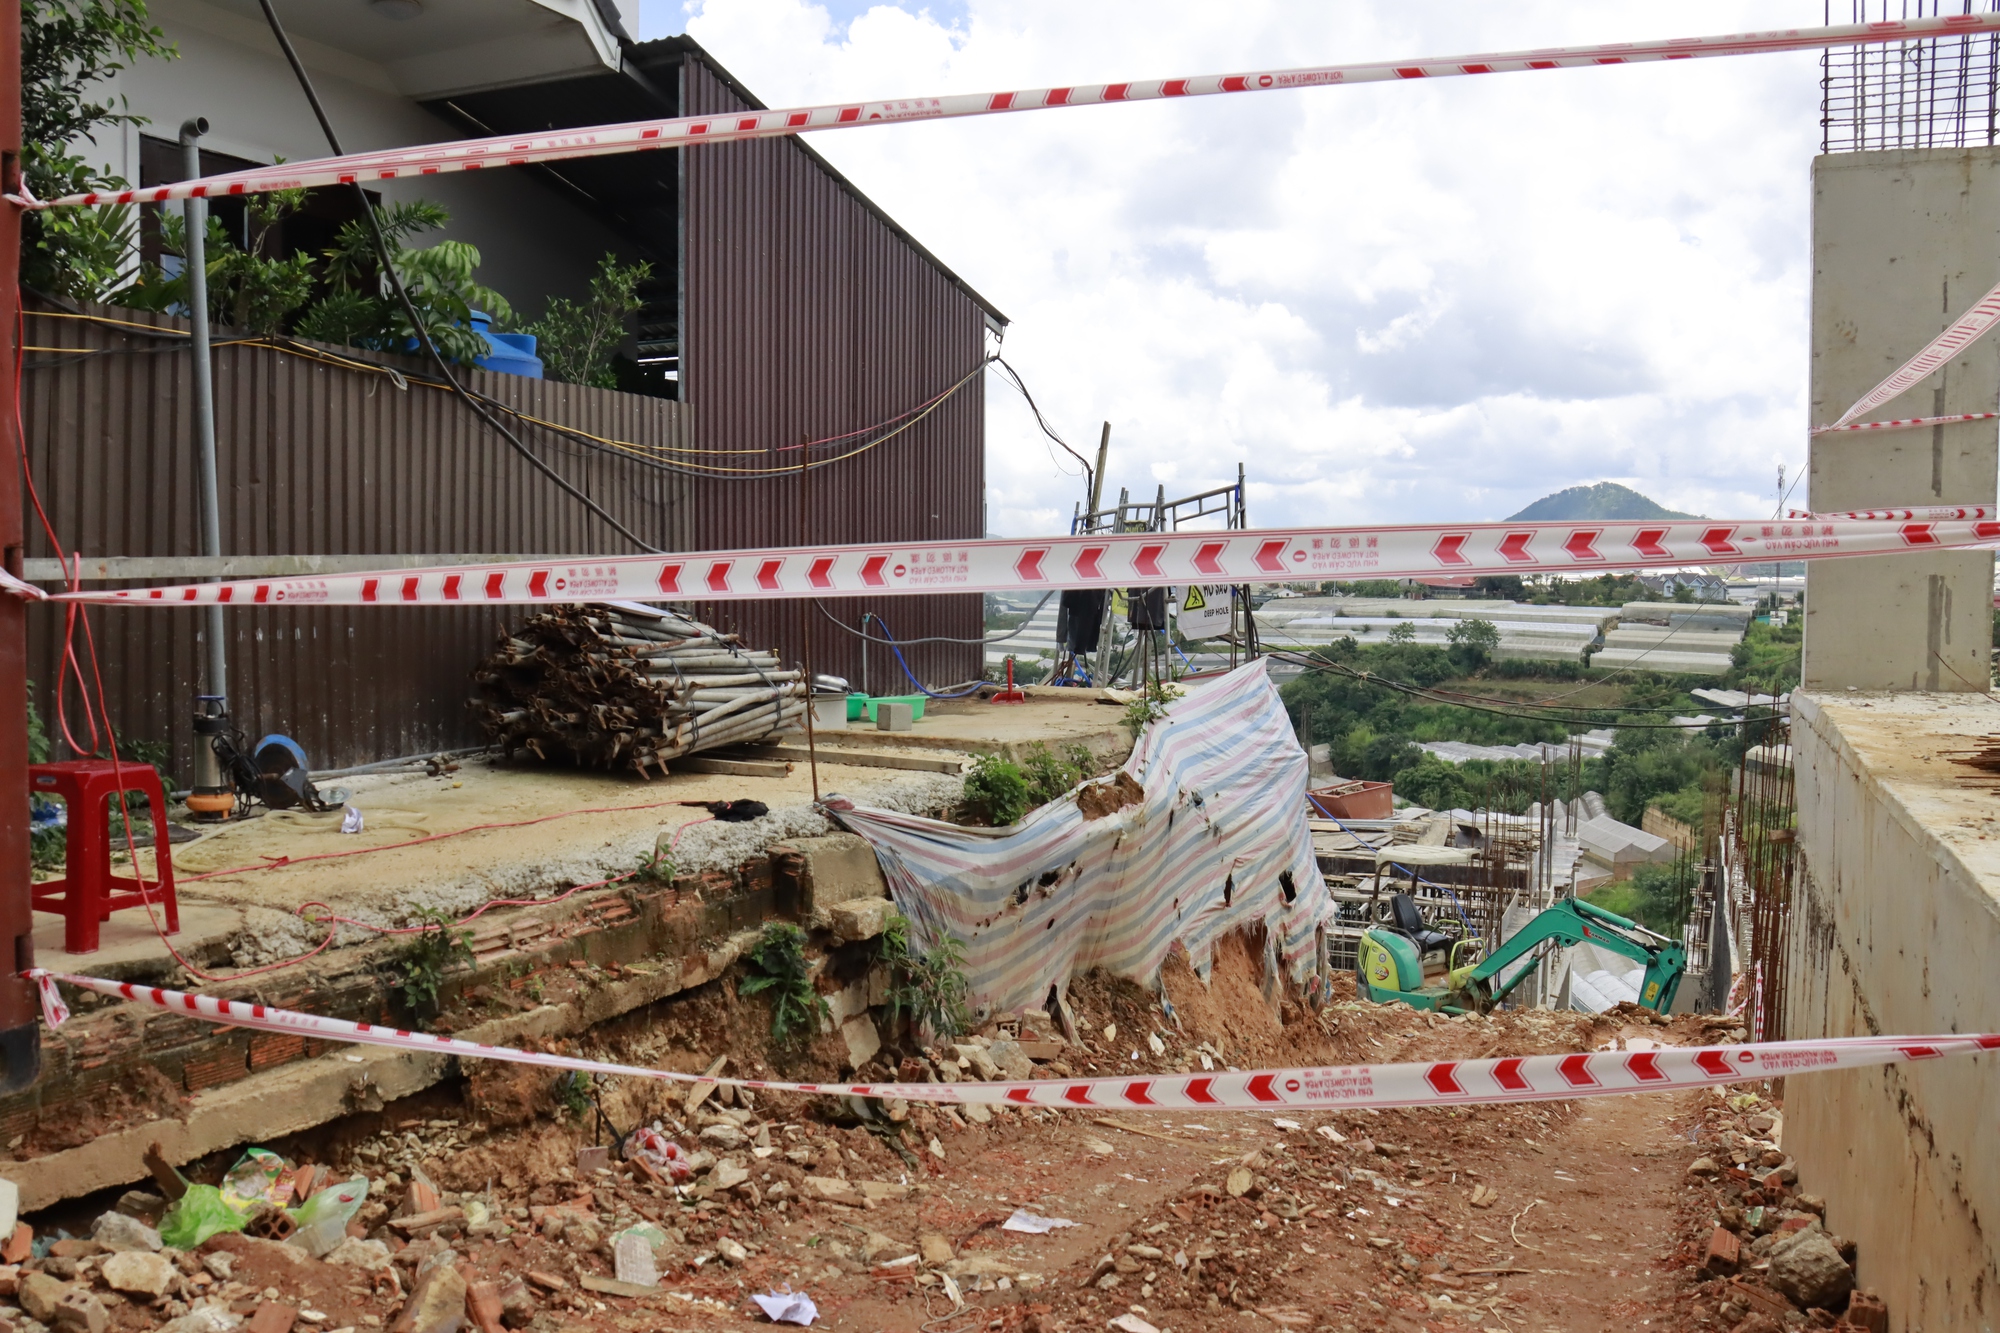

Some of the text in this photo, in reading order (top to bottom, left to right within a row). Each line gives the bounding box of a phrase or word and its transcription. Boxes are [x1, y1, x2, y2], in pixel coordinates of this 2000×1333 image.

[1312, 552, 1330, 560] AREA
[1331, 551, 1363, 559] ALLOWED
[1204, 606, 1229, 618] DEEP HOLE
